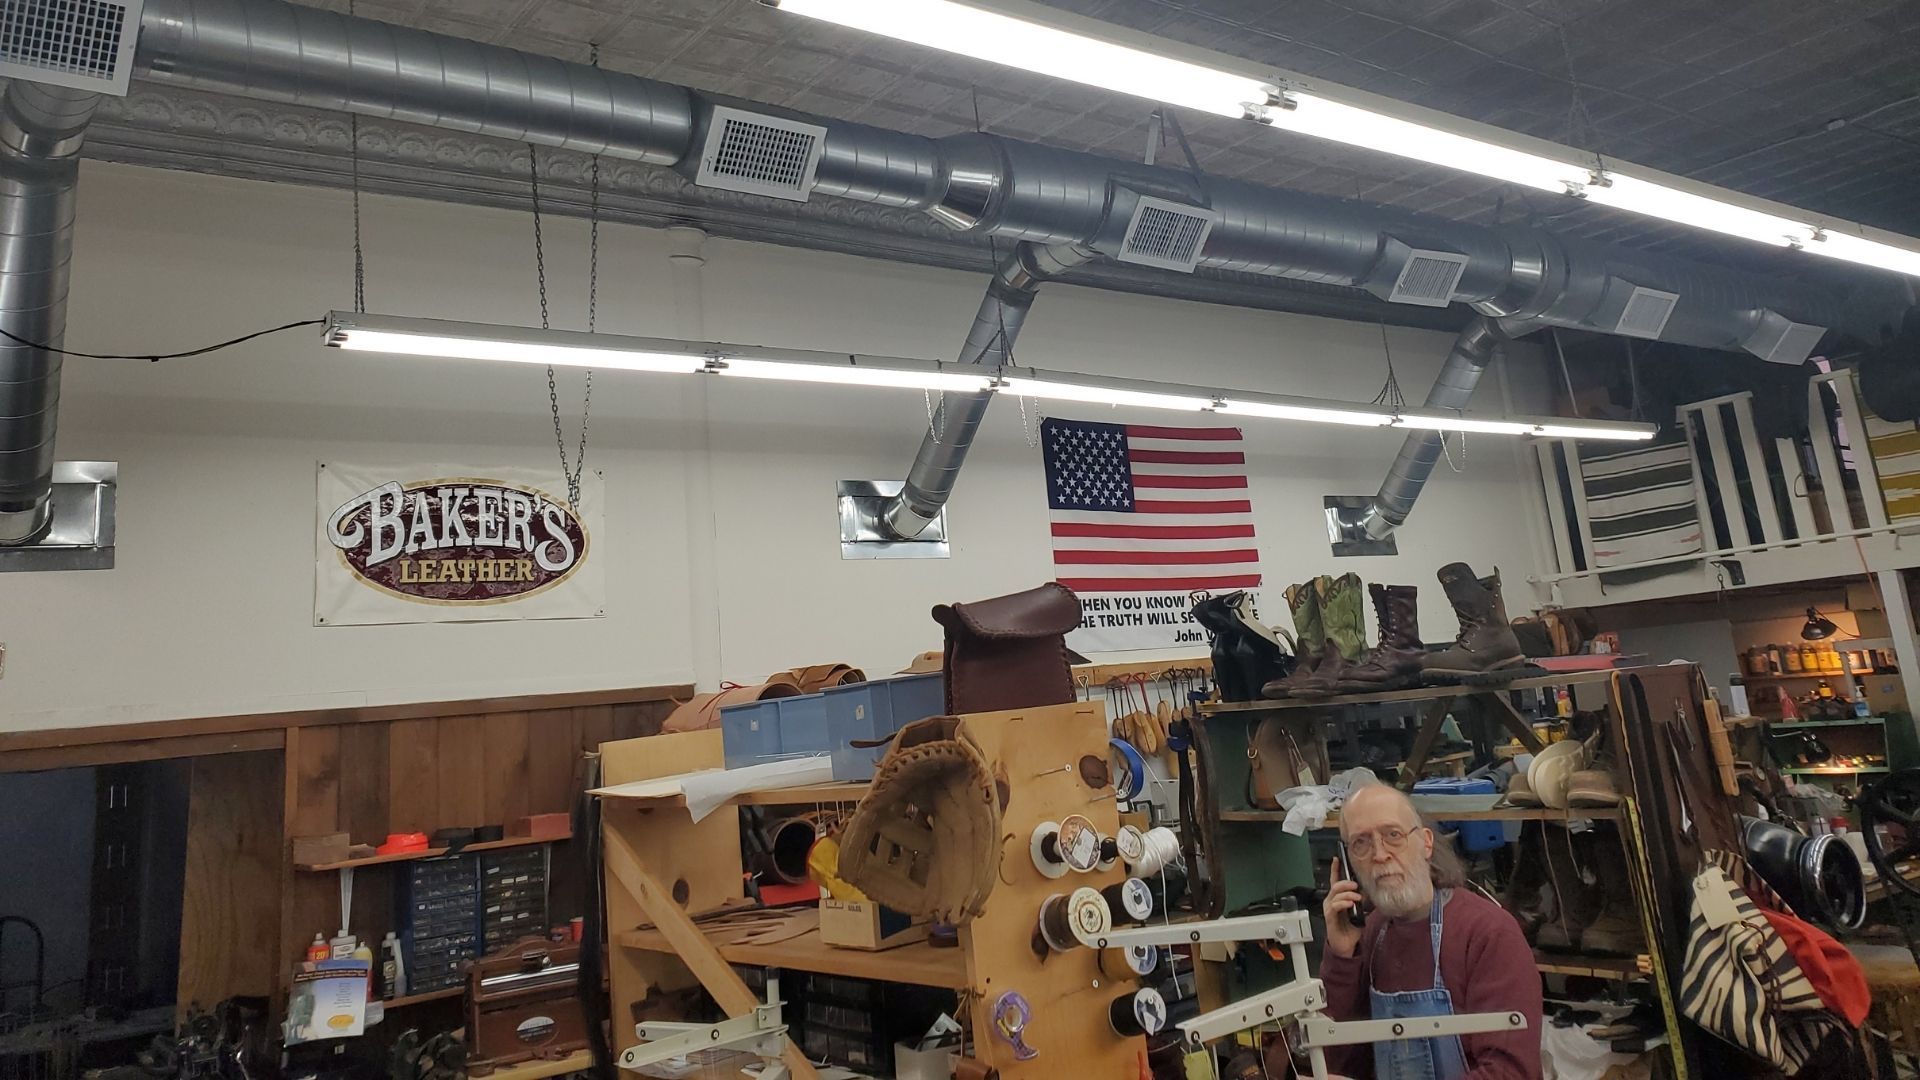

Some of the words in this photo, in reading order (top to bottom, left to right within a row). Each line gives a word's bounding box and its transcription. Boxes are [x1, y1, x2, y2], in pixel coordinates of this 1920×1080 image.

[327, 481, 574, 571] BAKER'S
[400, 559, 534, 583] LEATHER
[1080, 598, 1111, 611] HEN
[1113, 597, 1142, 610] YOU
[1145, 595, 1185, 609] KNOW
[1078, 615, 1096, 628] HE
[1098, 613, 1143, 627] TRUTH
[1147, 612, 1178, 625] WILL
[1181, 611, 1196, 624] SE
[1174, 629, 1203, 643] John
